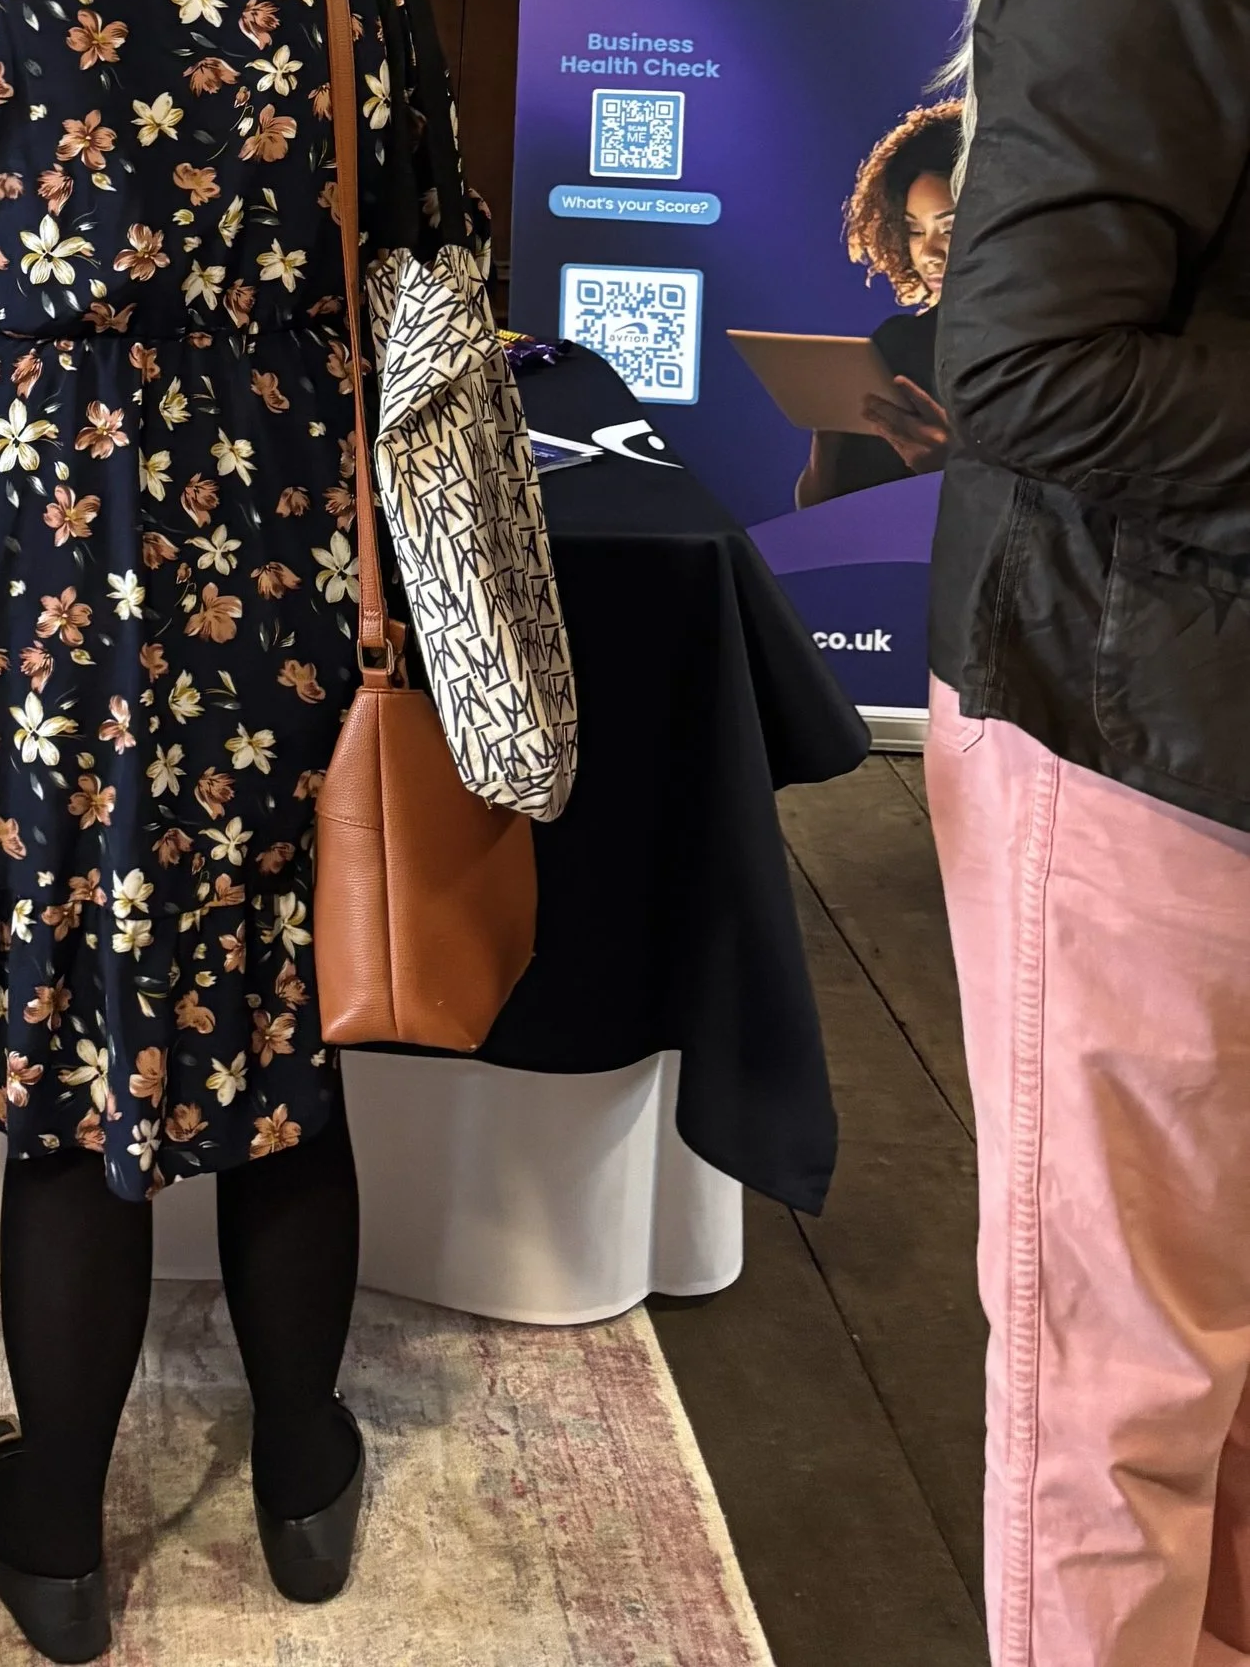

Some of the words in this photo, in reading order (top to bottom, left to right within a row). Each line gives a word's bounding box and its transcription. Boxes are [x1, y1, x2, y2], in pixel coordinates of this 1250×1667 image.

[588, 32, 693, 53] Business
[561, 56, 637, 74] Health
[644, 58, 720, 77] Check
[627, 133, 646, 143] ME
[618, 200, 652, 213] your
[656, 200, 708, 214] Score?
[609, 334, 649, 343] avrion
